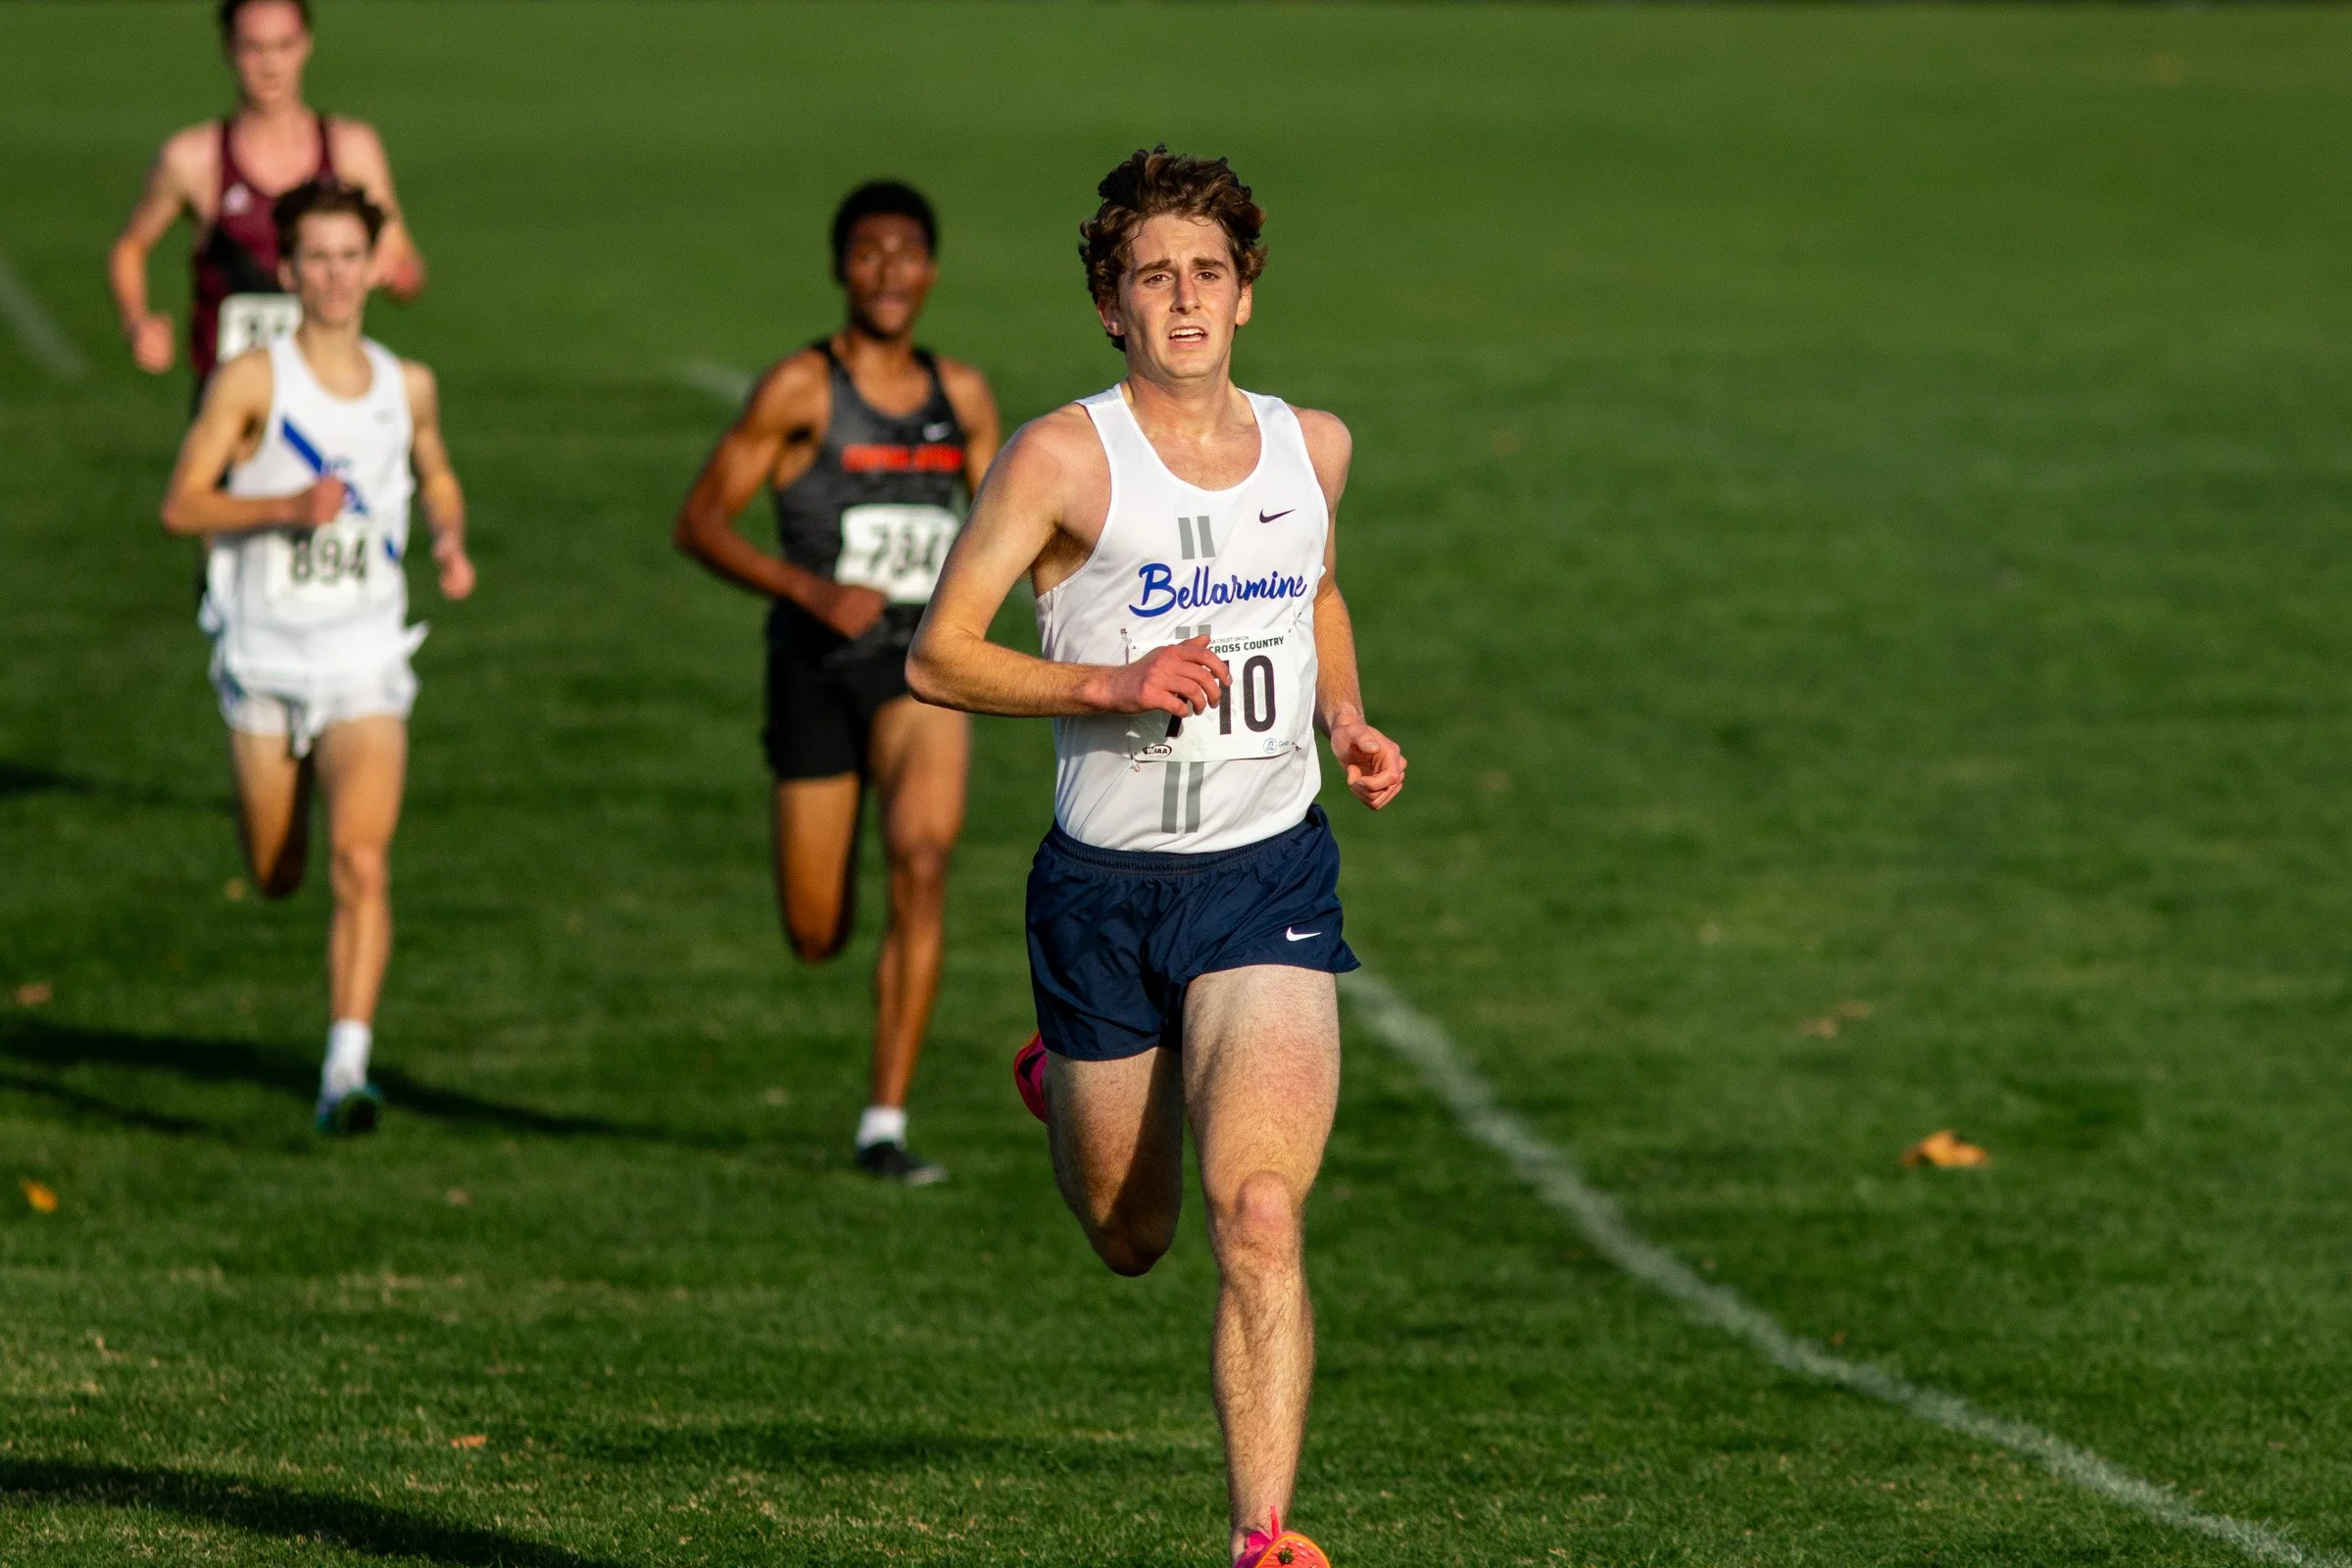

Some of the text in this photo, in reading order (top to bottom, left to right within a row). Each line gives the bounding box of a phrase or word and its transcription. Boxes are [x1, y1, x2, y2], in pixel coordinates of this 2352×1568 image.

[290, 531, 368, 585] 894
[1129, 563, 1307, 617] Bellarmine
[1244, 636, 1284, 651] COUNTRY
